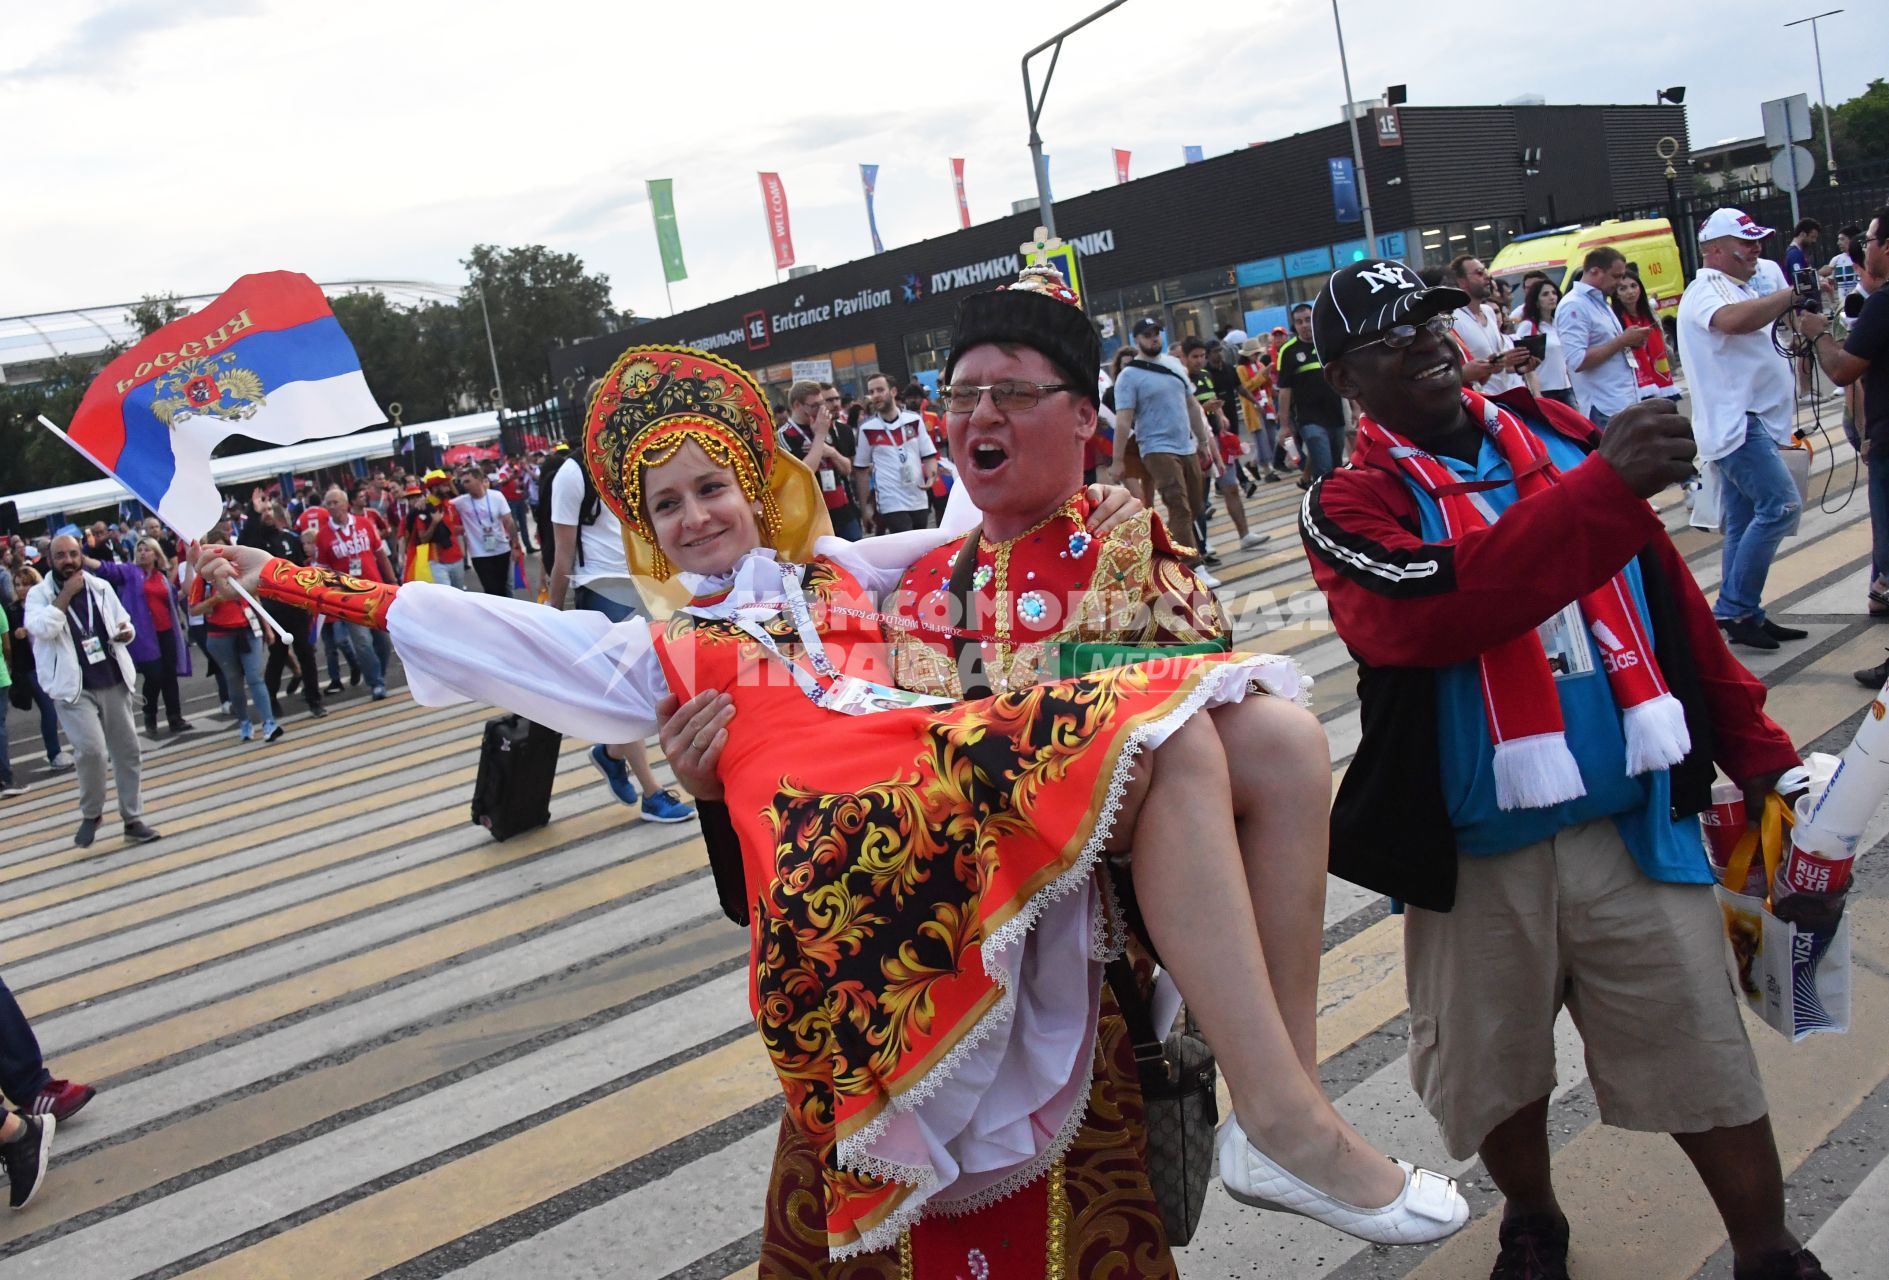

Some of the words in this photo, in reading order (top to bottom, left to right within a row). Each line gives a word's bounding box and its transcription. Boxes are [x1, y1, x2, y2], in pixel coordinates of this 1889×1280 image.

[1379, 115, 1397, 133] 1E
[768, 179, 785, 237] WELCOME
[930, 253, 1020, 294] ЛУЖНИКИ
[1357, 263, 1415, 293] NY
[1648, 262, 1662, 275] 103
[772, 305, 830, 334] Entrance
[834, 289, 892, 318] Pavilion
[749, 320, 765, 339] 1E
[866, 612, 885, 622] CUP
[886, 615, 919, 629] WORLD
[1604, 650, 1639, 673] das
[1796, 860, 1831, 880] RUS
[1793, 932, 1815, 966] VISA
